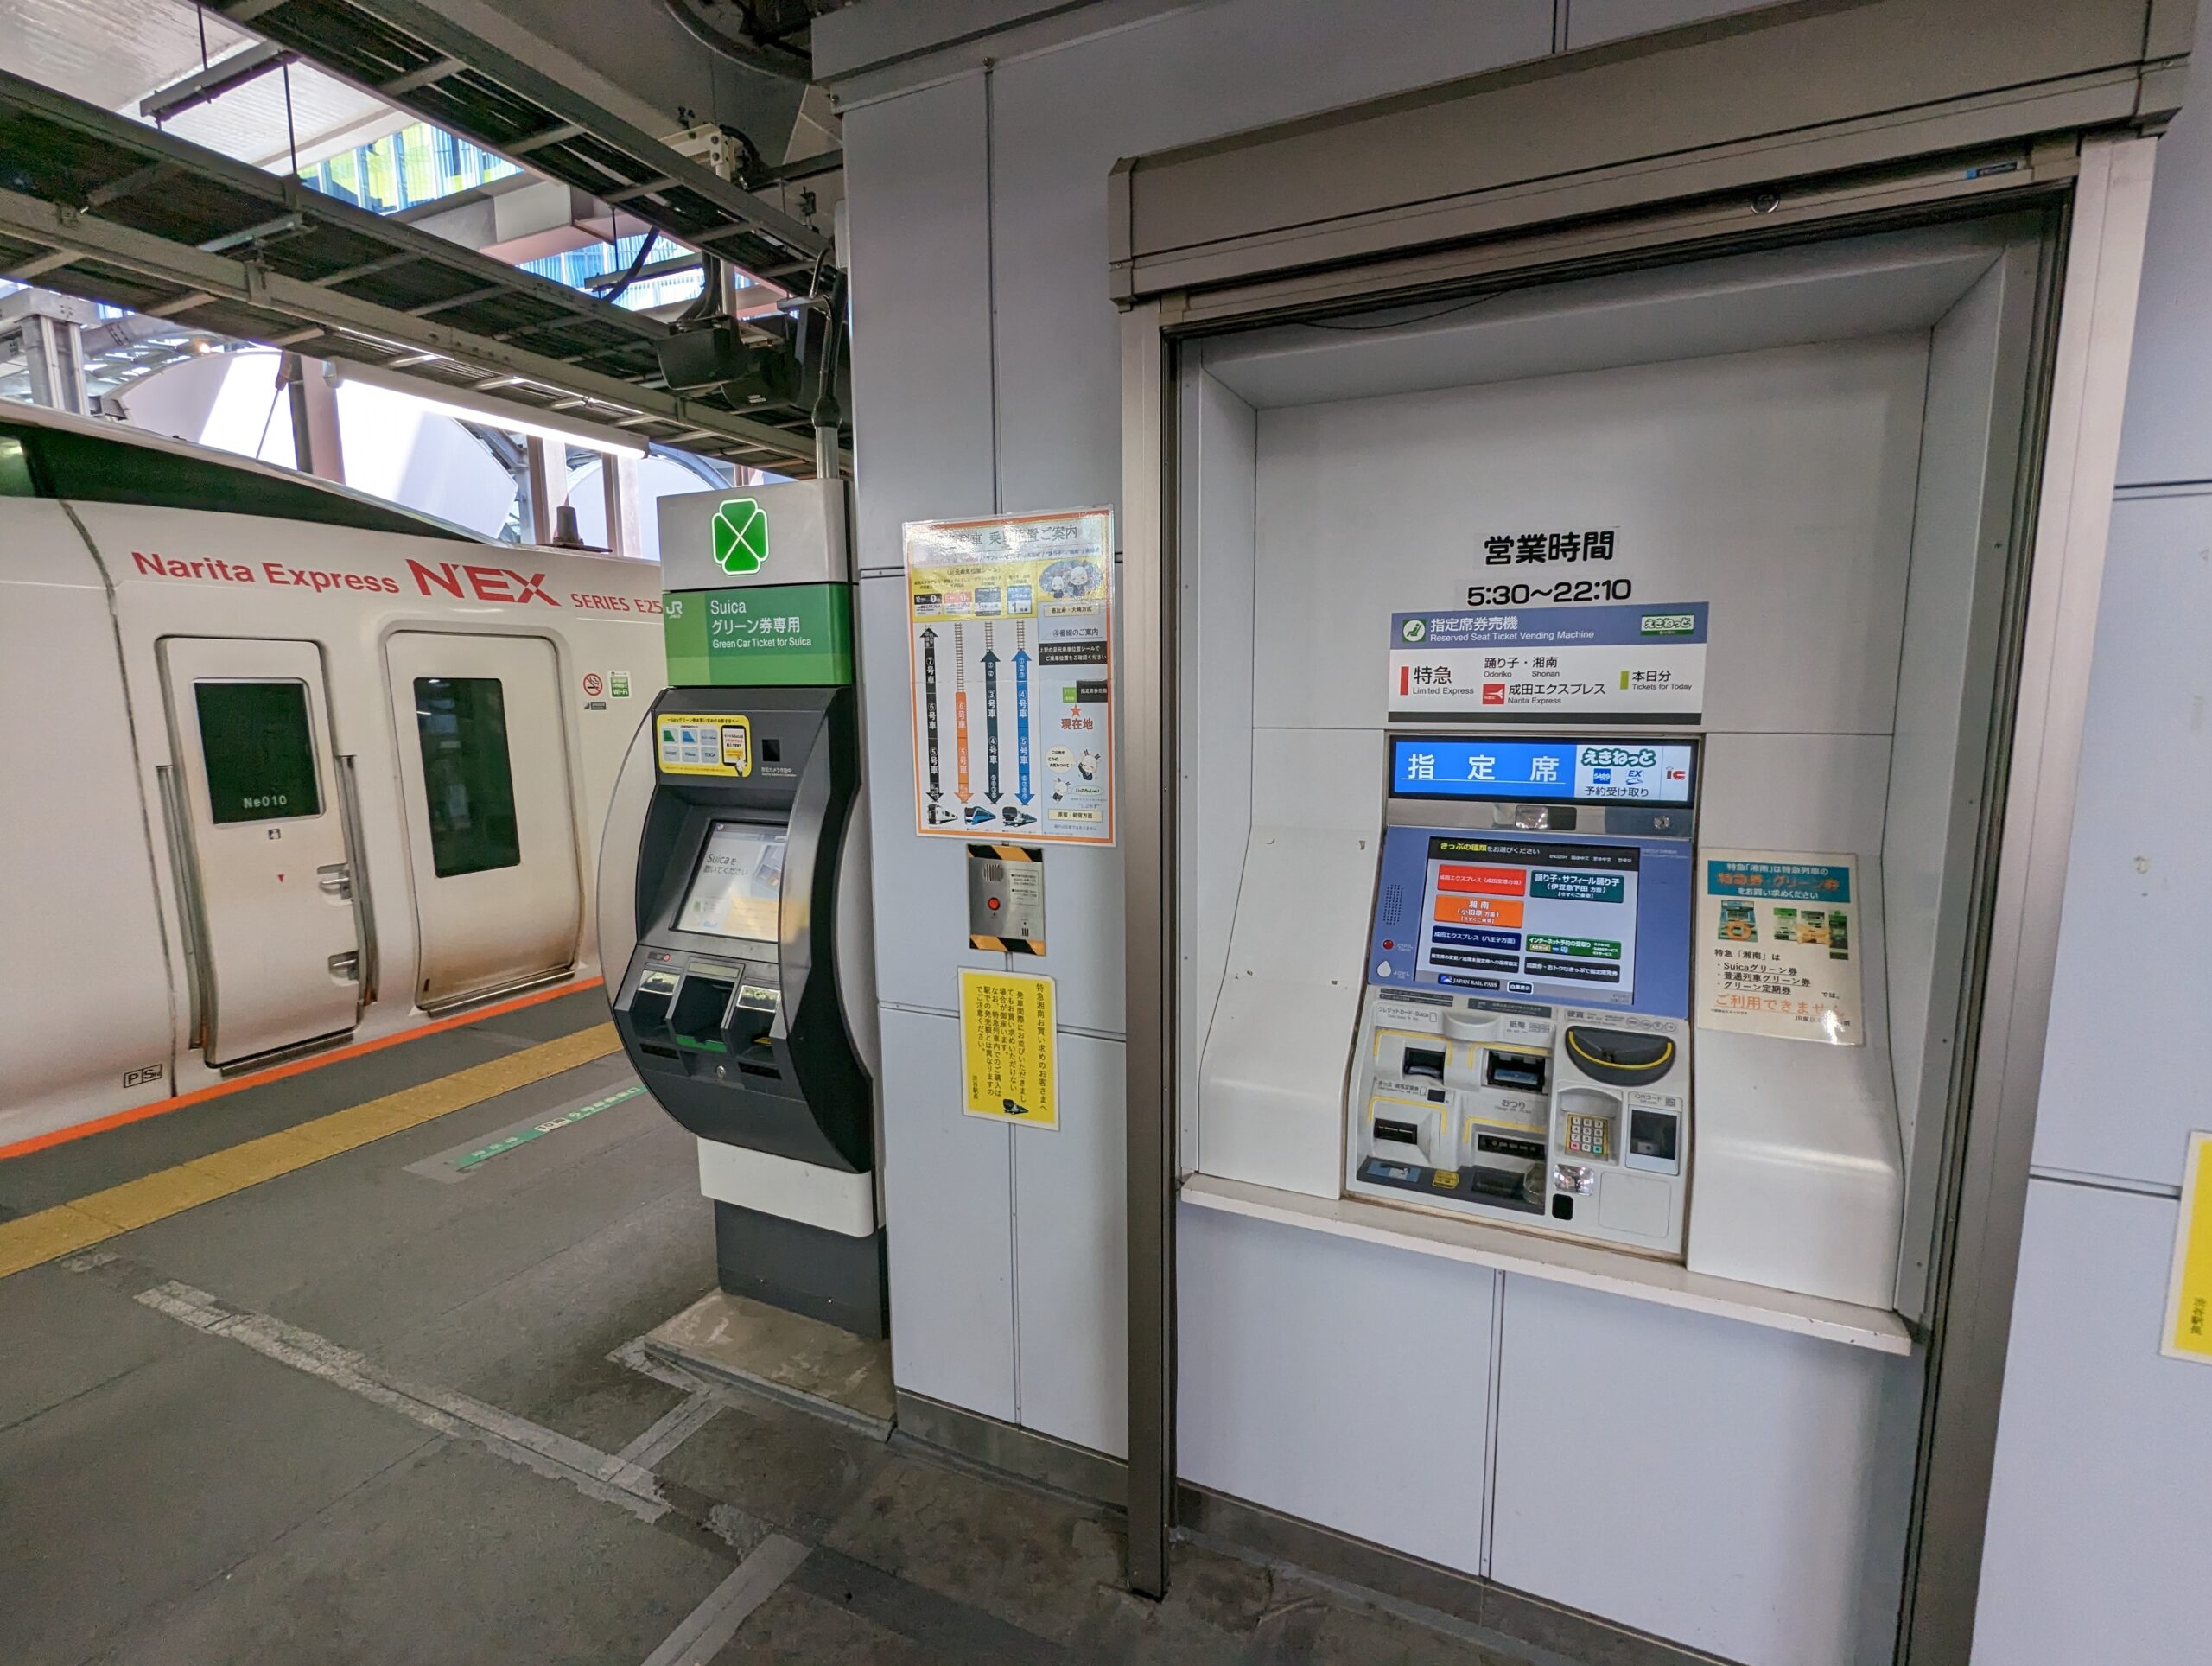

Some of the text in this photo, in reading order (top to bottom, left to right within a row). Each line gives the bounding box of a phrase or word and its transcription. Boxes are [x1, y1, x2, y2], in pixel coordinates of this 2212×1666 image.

[1484, 530, 1615, 565] 営業時間
[131, 551, 255, 582] Narita
[261, 562, 400, 593] Express
[570, 593, 630, 612] SERIES
[665, 601, 683, 614] JR
[710, 600, 747, 614] Suica
[711, 616, 801, 635] グリーン券専用
[1430, 616, 1518, 632] 指定席券売機
[1644, 617, 1691, 629] えきねっと
[713, 637, 811, 648] Green Car Ticket for Suica
[1430, 630, 1594, 642] Reserved Seat Ticket Vending Machine
[1413, 666, 1452, 685] 特急
[1632, 671, 1672, 683] 本日分
[1443, 687, 1474, 697] Express
[1508, 684, 1606, 696] 成田エクスプレス
[1531, 696, 1561, 706] Express
[1061, 718, 1093, 730] 現在地
[1581, 747, 1657, 767] えきねっと
[1584, 786, 1649, 798] 予約受け取り
[244, 795, 287, 809] Ne010
[1726, 862, 1829, 875] 特急「湘南」は特急列車の
[1738, 887, 1819, 900] をお買い求めください
[1714, 948, 1781, 962] 特急「湘南」は
[1036, 982, 1048, 1111] 特急湘南お買い求めのお客さまへ
[1501, 1099, 1526, 1110] おつり
